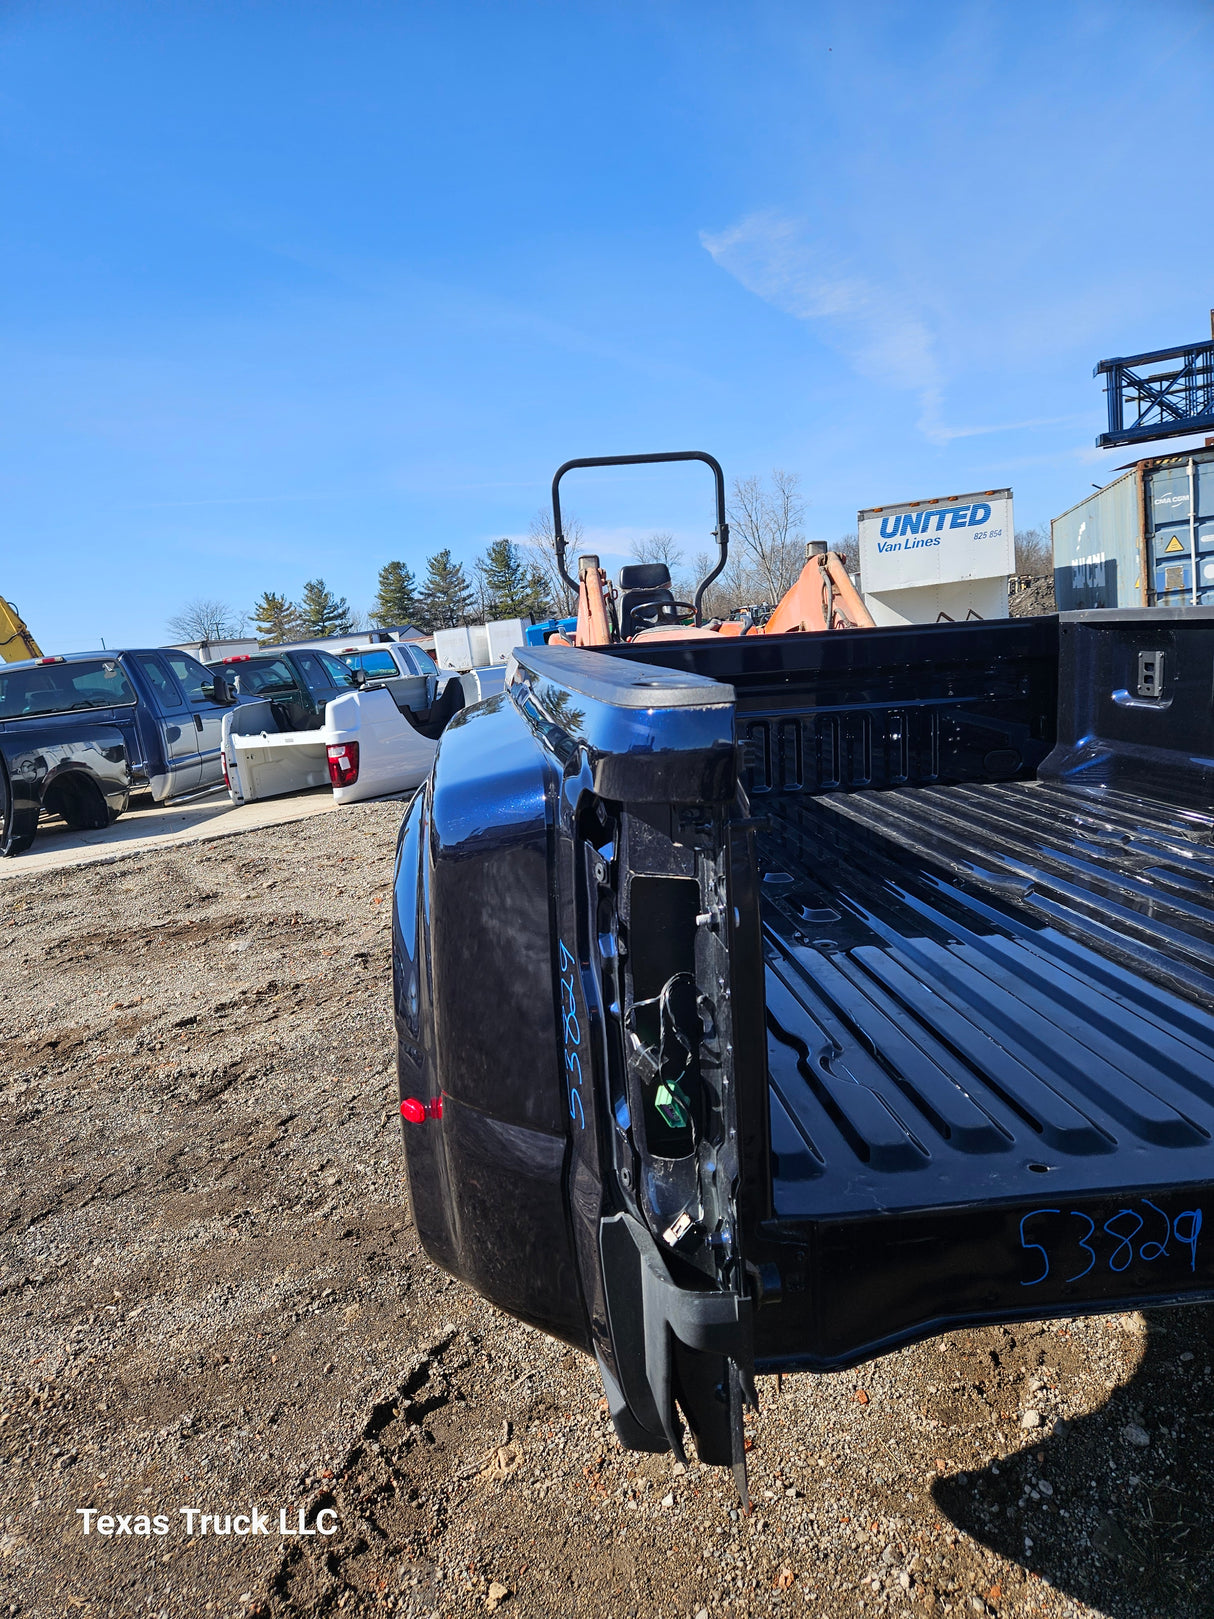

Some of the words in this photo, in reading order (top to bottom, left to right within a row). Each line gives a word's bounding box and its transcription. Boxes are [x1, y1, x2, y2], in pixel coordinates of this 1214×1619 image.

[1154, 497, 1172, 505] CMA
[1172, 494, 1190, 502] CGM
[880, 502, 992, 539] UNITED
[877, 538, 901, 553] Van
[904, 536, 941, 550] Lines
[973, 531, 988, 541] 825
[559, 938, 585, 1130] 53829
[1019, 1198, 1203, 1286] 53829
